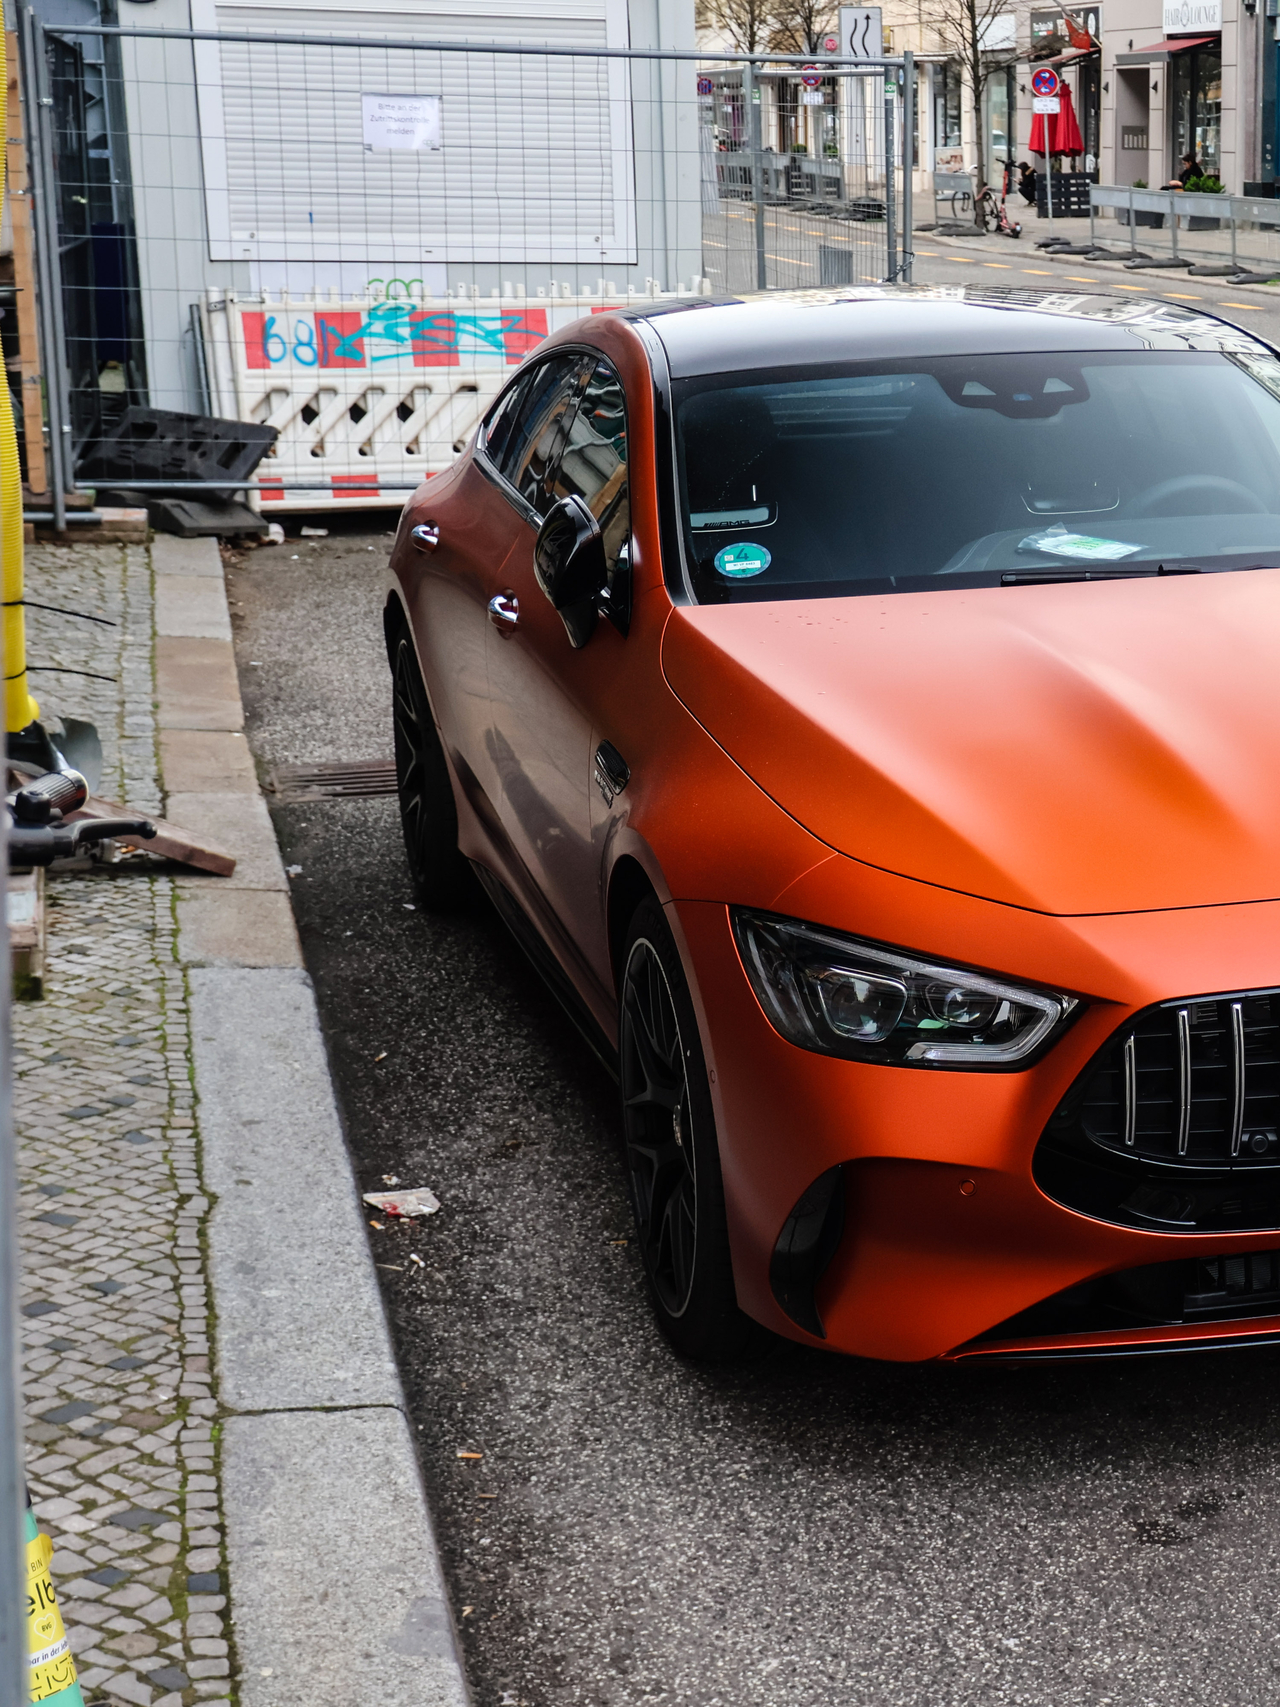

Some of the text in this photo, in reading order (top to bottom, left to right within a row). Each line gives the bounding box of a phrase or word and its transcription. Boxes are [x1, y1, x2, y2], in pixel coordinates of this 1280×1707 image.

[1165, 5, 1218, 26] HAIR LOUNGE
[386, 127, 415, 135] melden
[736, 547, 749, 560] 4
[31, 1558, 43, 1572] BIN
[41, 1622, 52, 1632] BVG
[42, 1652, 49, 1660] in
